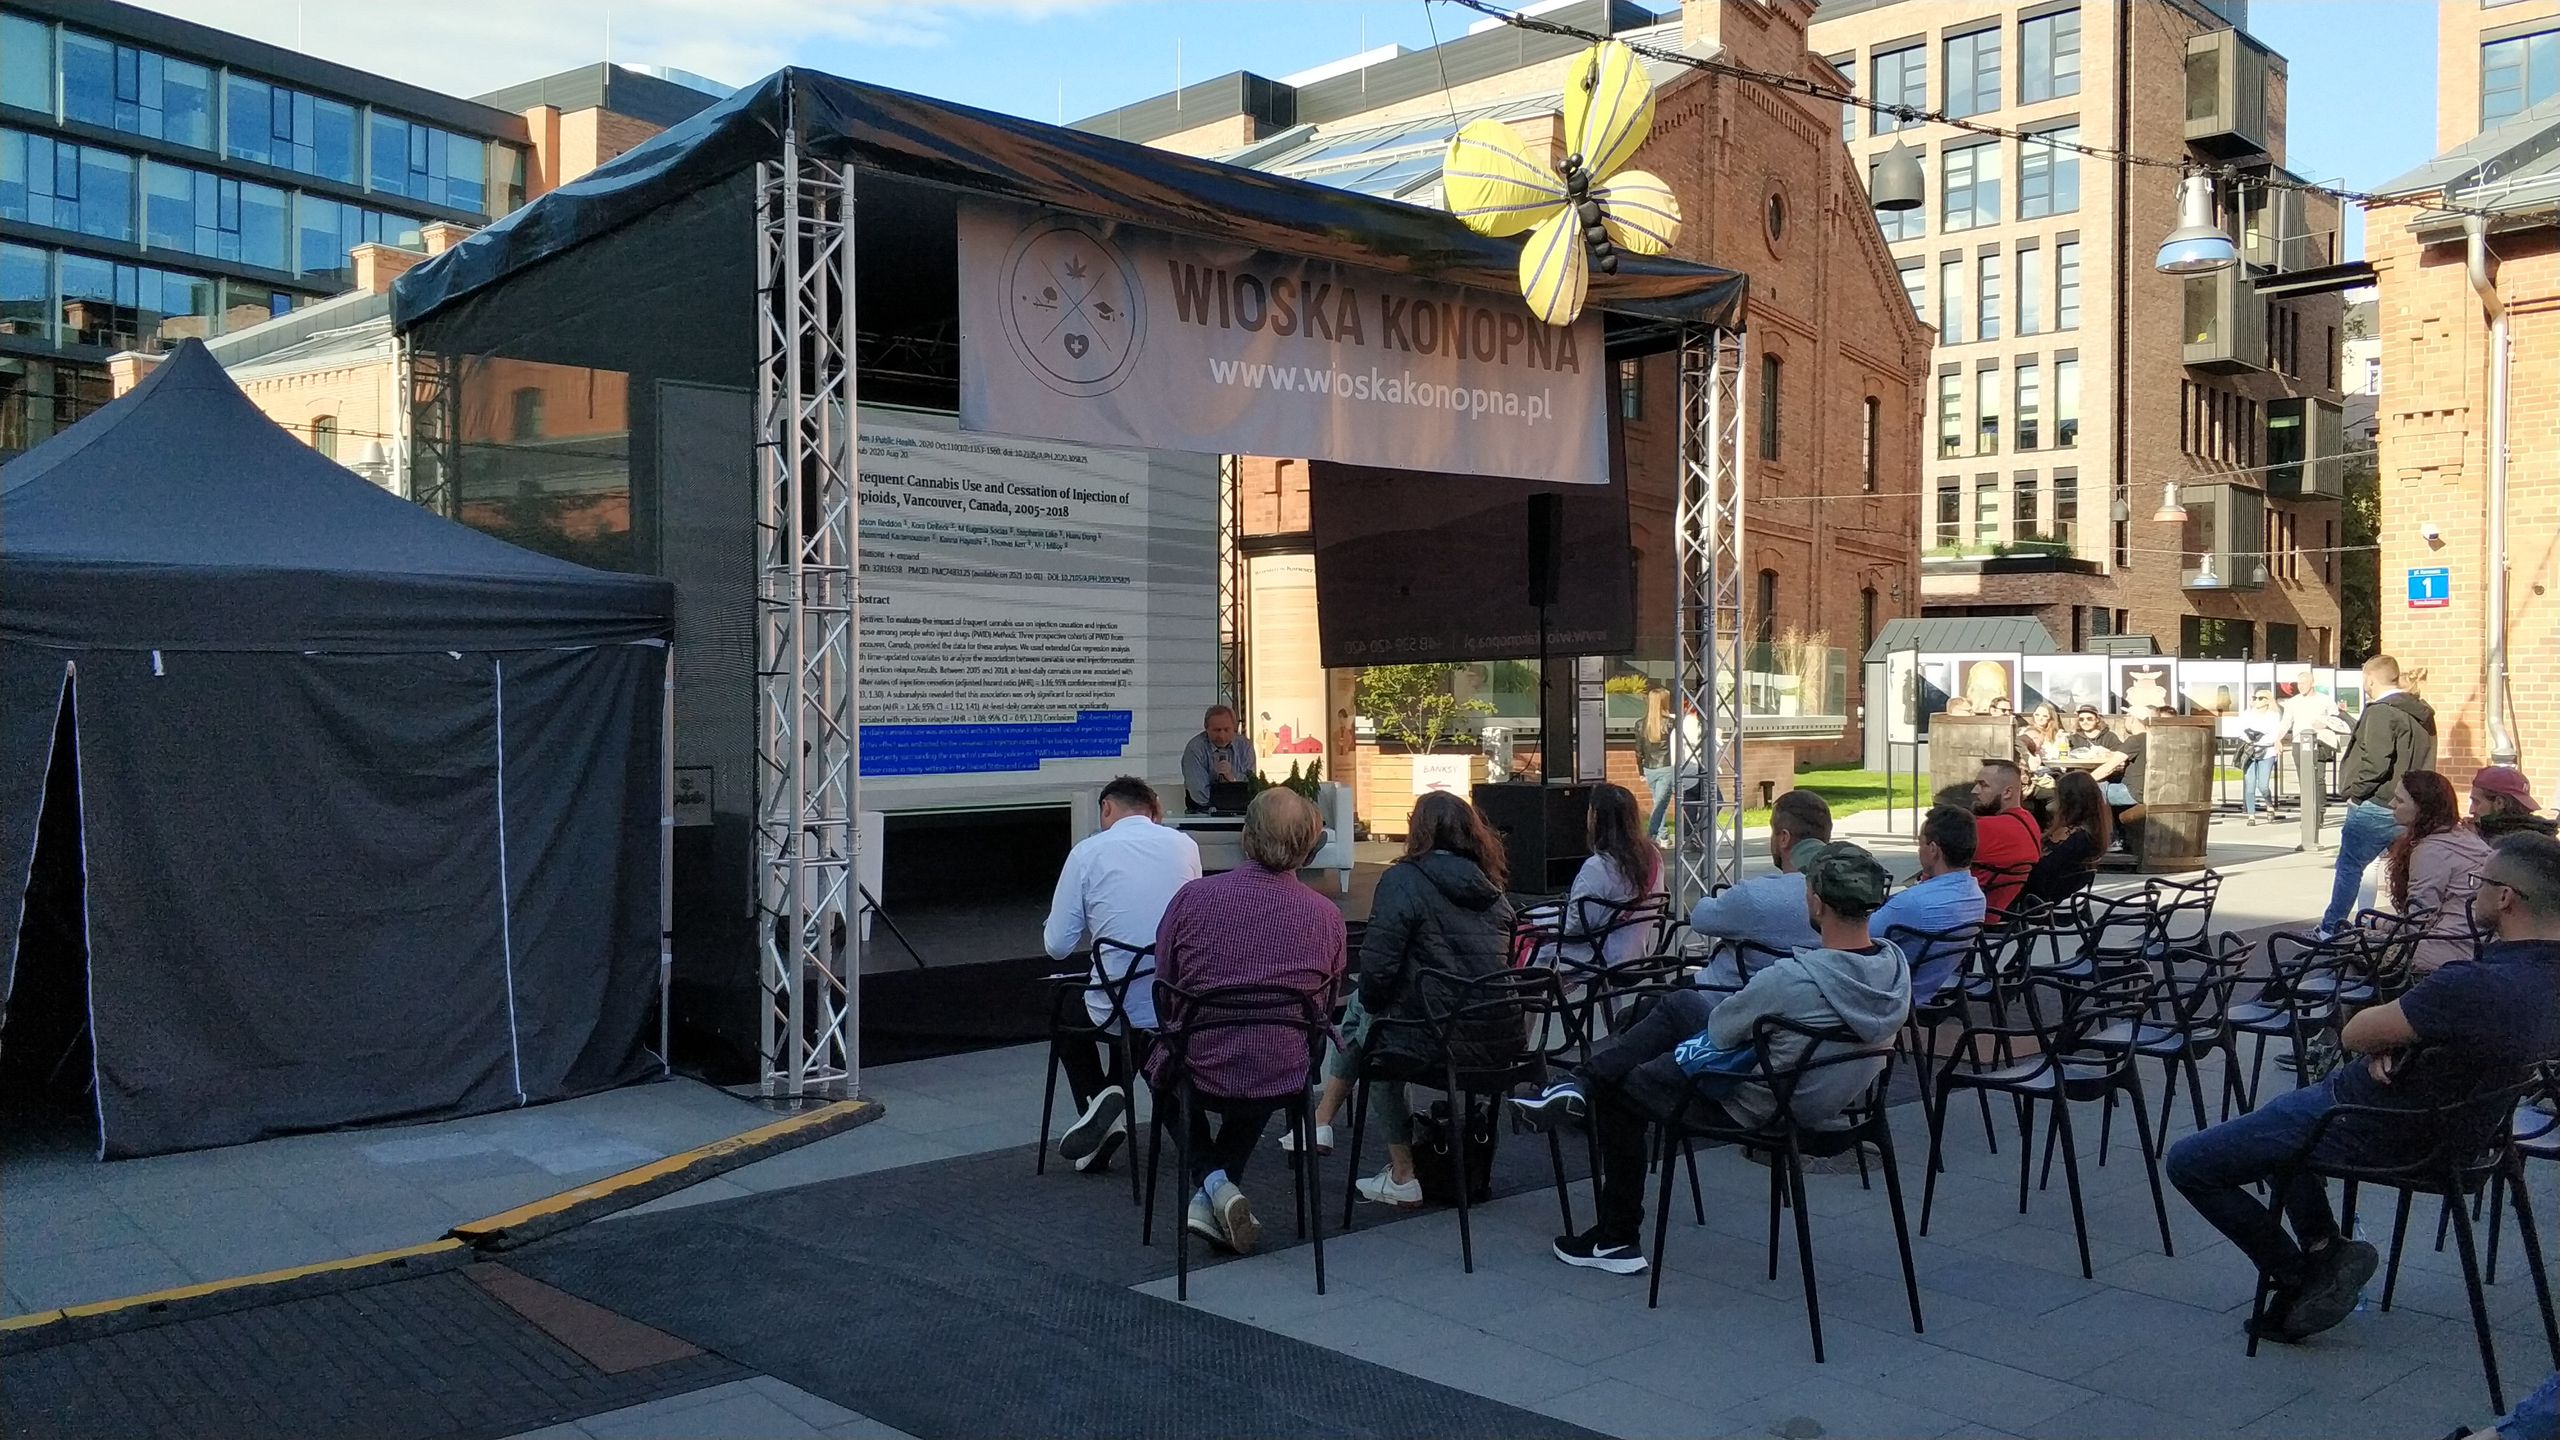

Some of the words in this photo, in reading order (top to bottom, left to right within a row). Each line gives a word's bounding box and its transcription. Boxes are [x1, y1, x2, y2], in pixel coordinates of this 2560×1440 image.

[1168, 260, 1364, 345] WIOSKA
[1381, 295, 1580, 375] KONOPNA
[1208, 354, 1552, 426] www.wioskakonopna.pl
[870, 448, 884, 456] 2020
[886, 450, 899, 458] Aug
[919, 440, 934, 448] 2020
[860, 473, 904, 487] requent
[907, 474, 960, 490] Cannabis
[962, 479, 982, 492] Use
[984, 482, 1004, 494] and
[1007, 483, 1058, 498] Cessation
[1060, 488, 1071, 499] of
[1072, 488, 1117, 504] Injection
[1119, 492, 1130, 504] of
[858, 490, 900, 508] pioids,
[903, 493, 966, 513] Vancouver,
[968, 499, 1012, 516] Canada,
[1014, 504, 1070, 518] 2005-2018
[2422, 577, 2432, 598] 1
[858, 596, 890, 604] bstract
